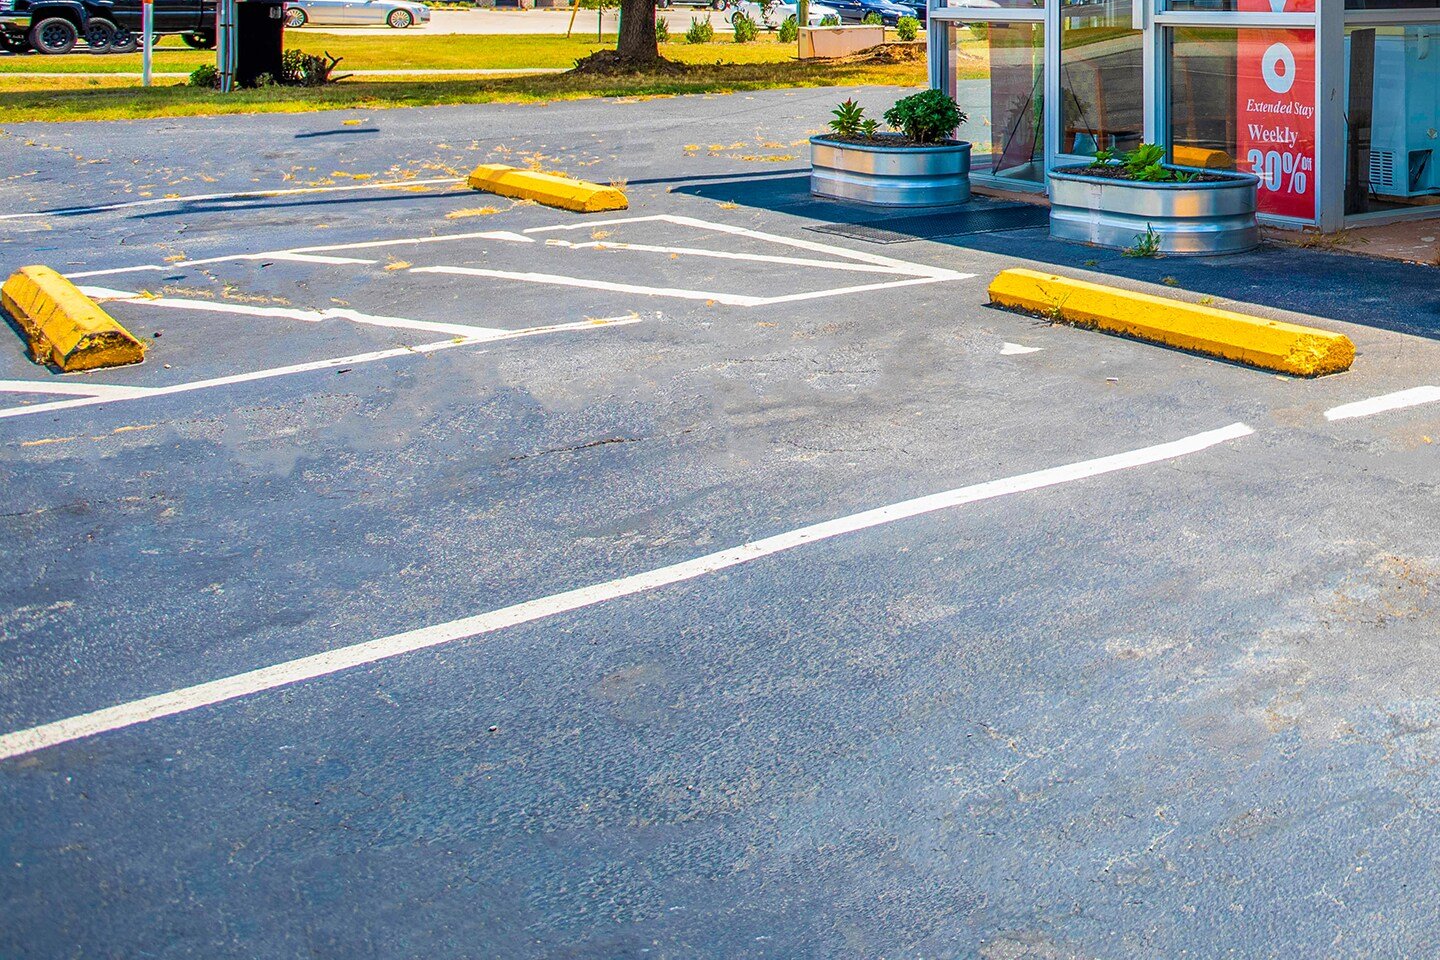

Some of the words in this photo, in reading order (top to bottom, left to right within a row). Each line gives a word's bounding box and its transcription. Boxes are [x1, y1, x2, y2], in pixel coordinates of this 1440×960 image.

[1246, 98, 1293, 114] Extended
[1293, 101, 1314, 118] Stay
[1247, 123, 1298, 148] Weekly
[1247, 148, 1307, 195] 30%
[1301, 156, 1312, 171] Off
